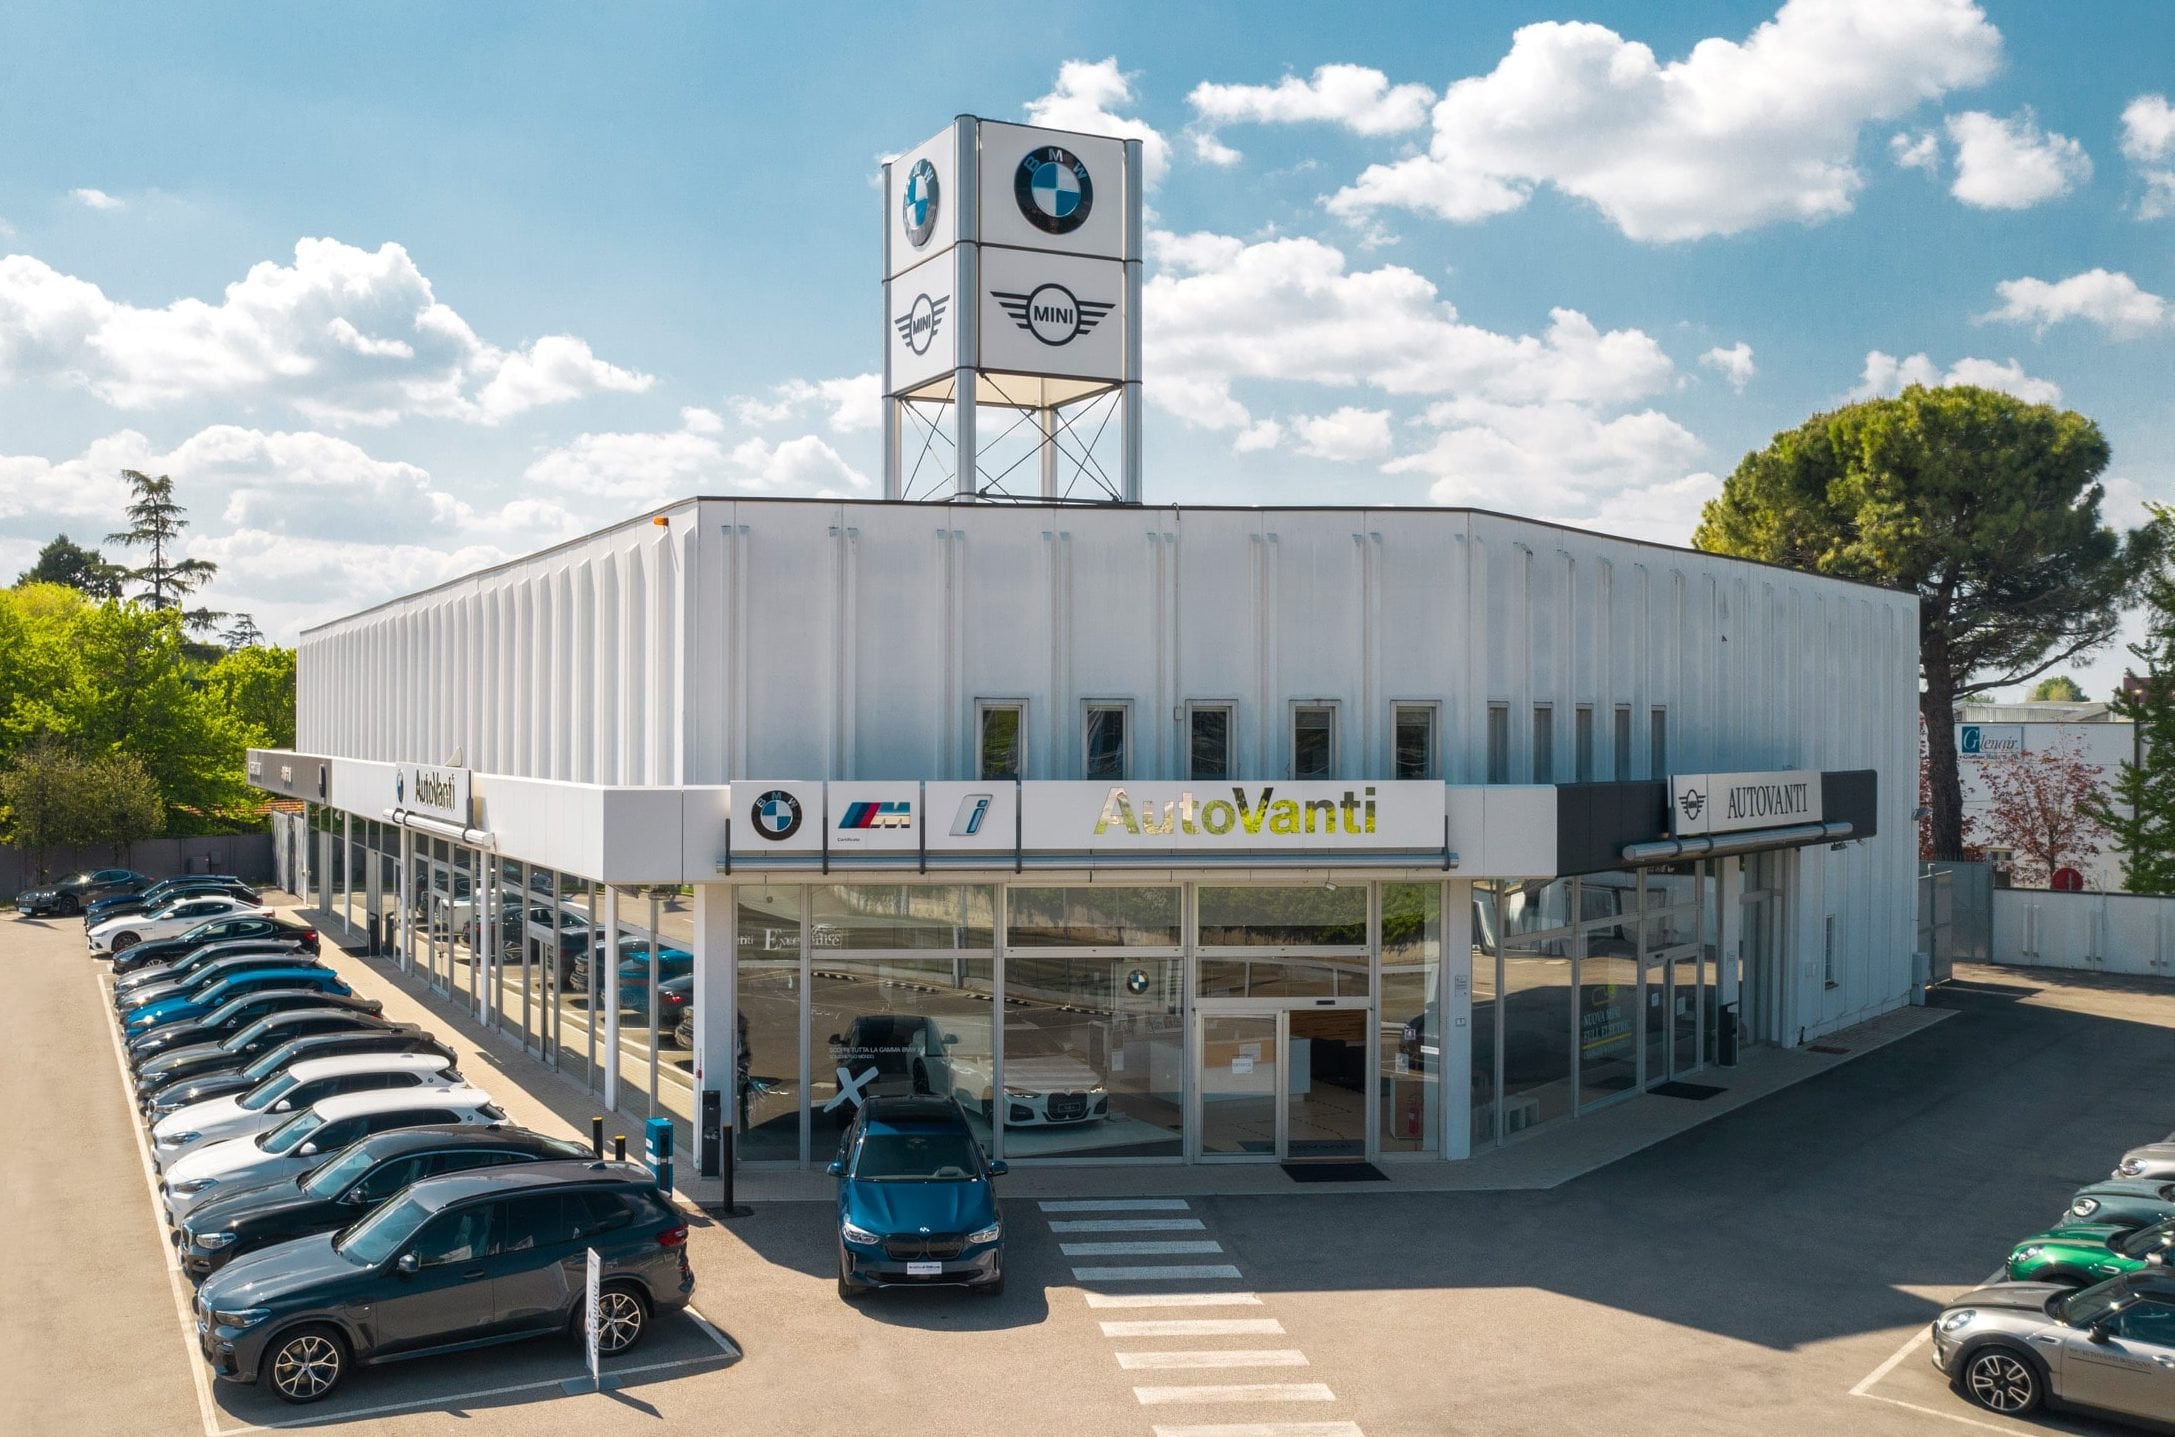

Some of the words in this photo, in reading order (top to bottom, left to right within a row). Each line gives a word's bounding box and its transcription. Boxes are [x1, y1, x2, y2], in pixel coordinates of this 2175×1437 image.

[1023, 150, 1088, 180] BMW
[912, 313, 931, 336] MINI
[1033, 304, 1074, 325] MINI
[1963, 727, 2019, 752] Glenair
[415, 769, 456, 811] AutoVanti
[755, 791, 799, 809] BMW
[1727, 783, 1808, 819] AUTOVANTI
[1093, 786, 1376, 836] AutoVanti
